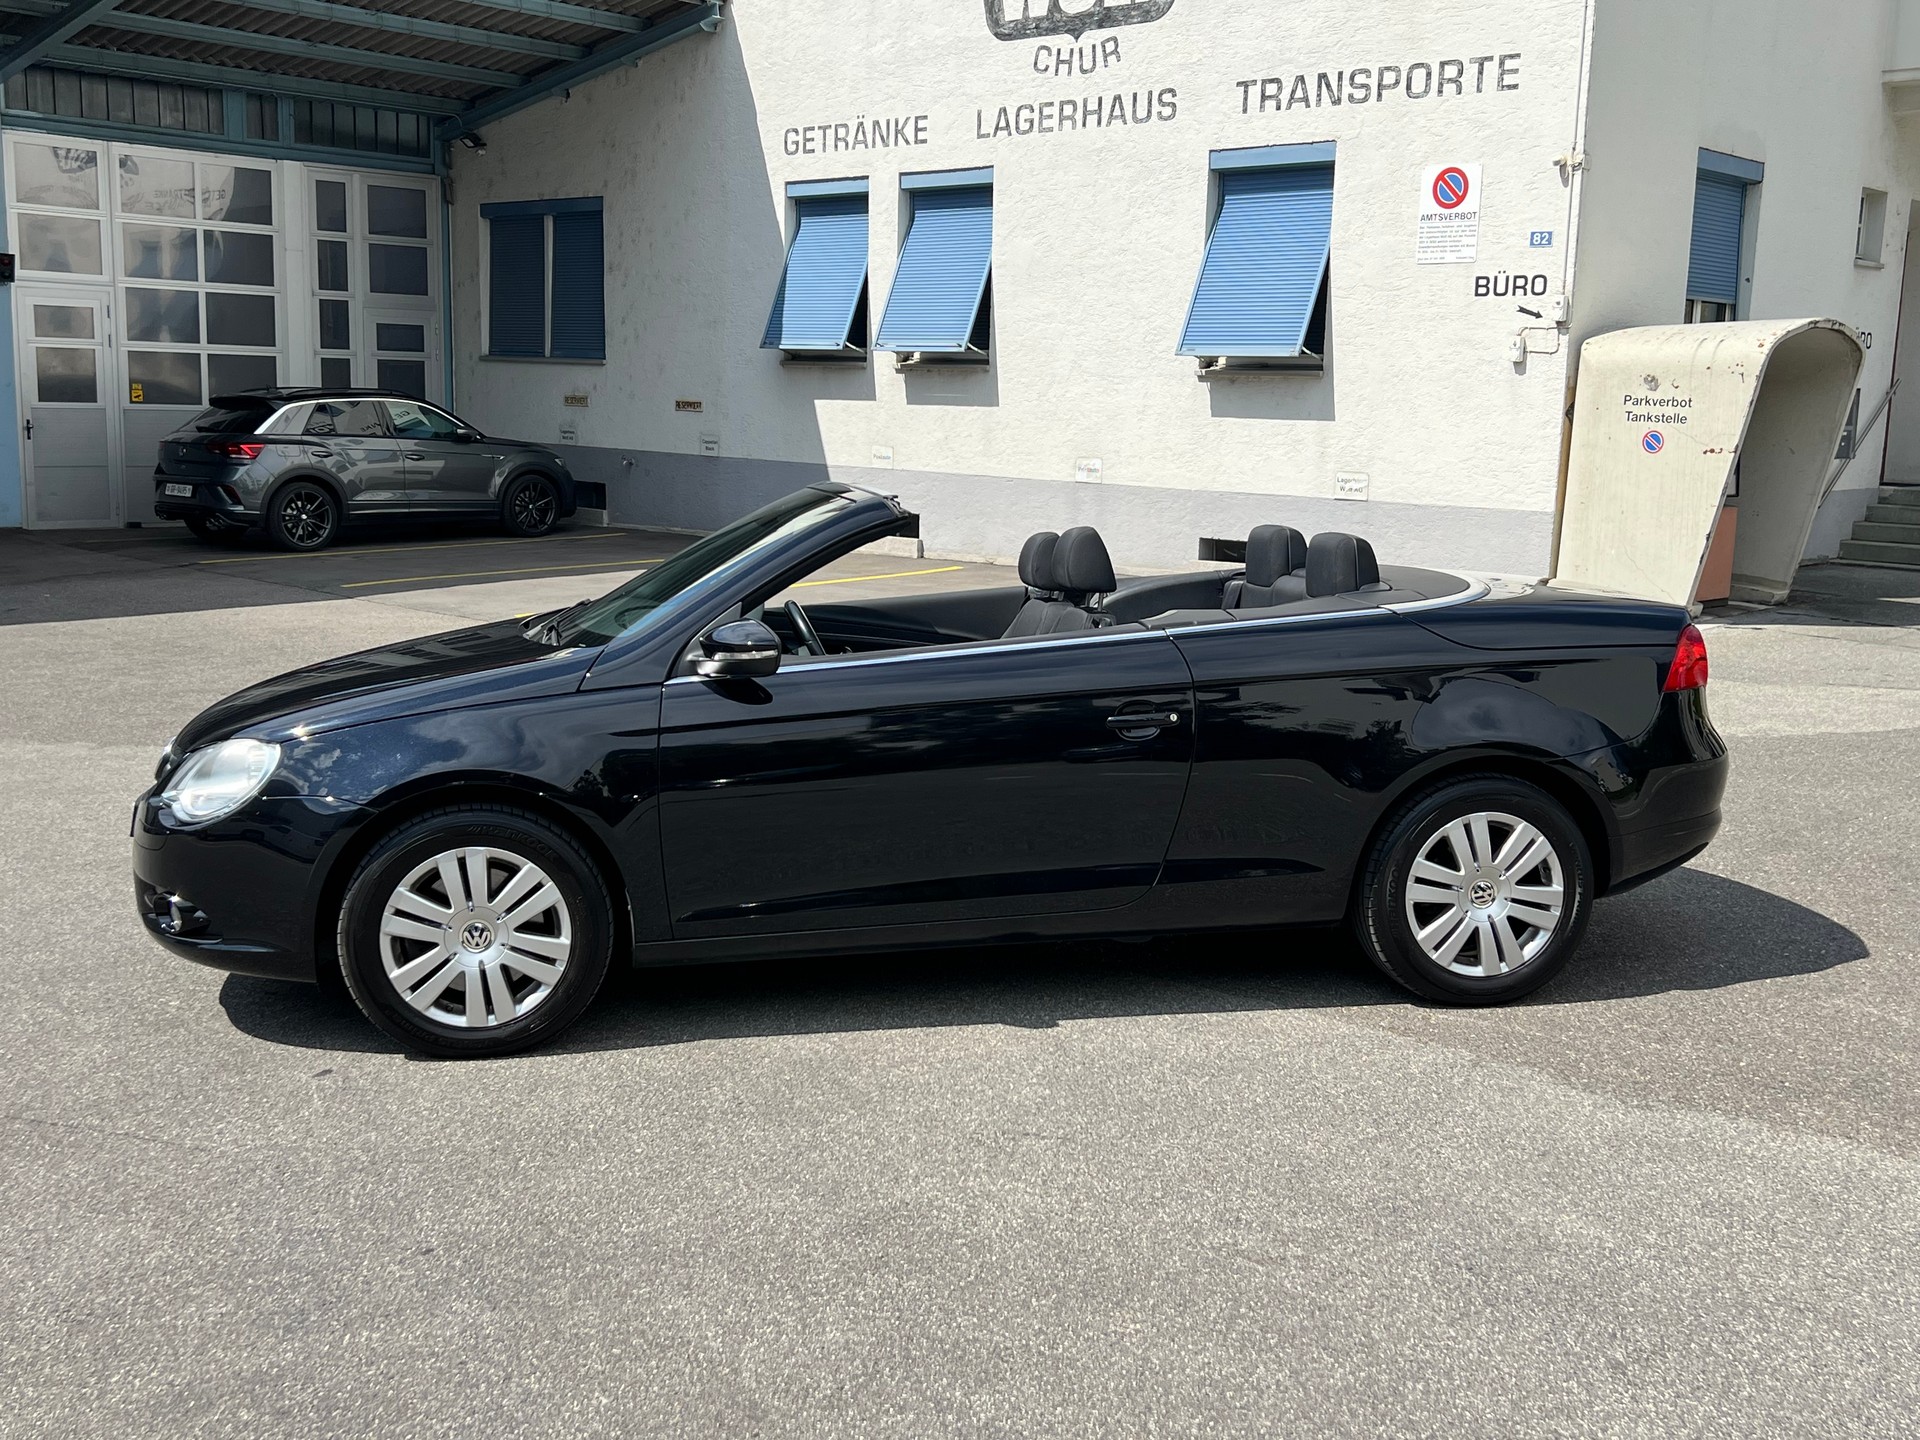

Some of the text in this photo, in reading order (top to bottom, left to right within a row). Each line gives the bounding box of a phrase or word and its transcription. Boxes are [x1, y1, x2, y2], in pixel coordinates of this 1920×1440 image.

[1033, 36, 1121, 76] CHUR
[1236, 53, 1521, 114] TRANSPORTE
[976, 88, 1178, 139] LAGERHAUS
[783, 114, 929, 155] GETRÄNKE
[1420, 212, 1477, 221] AMTSVERBOT
[1532, 232, 1549, 244] 82
[1474, 270, 1548, 297] BÜRO
[1624, 394, 1693, 408] Parkverbot
[1625, 411, 1688, 424] Tankstelle
